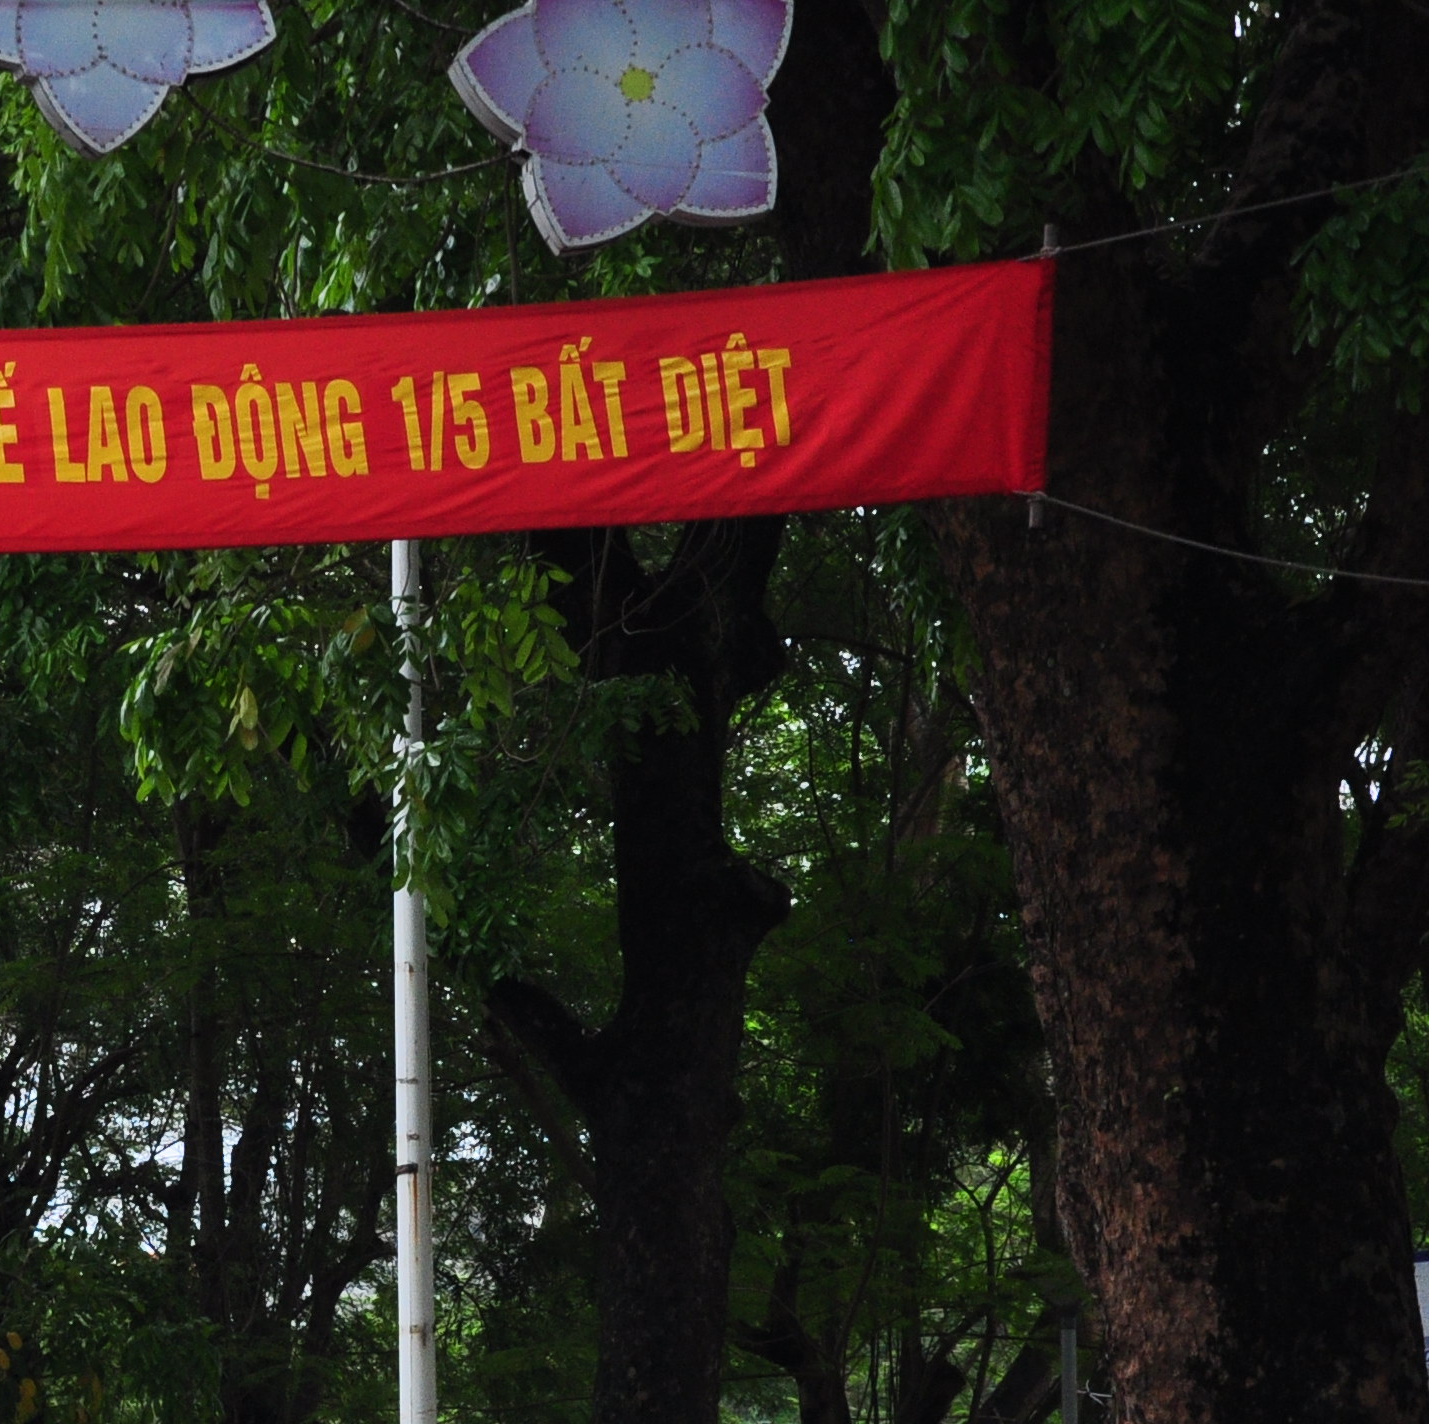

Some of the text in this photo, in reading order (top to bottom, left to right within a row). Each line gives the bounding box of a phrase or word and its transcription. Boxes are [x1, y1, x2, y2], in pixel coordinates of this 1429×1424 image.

[48, 386, 166, 482] LAO
[192, 364, 368, 498] ĐỘNG
[392, 371, 489, 470] 1/5
[511, 337, 627, 462] BẤT
[660, 333, 790, 467] DIỆT
